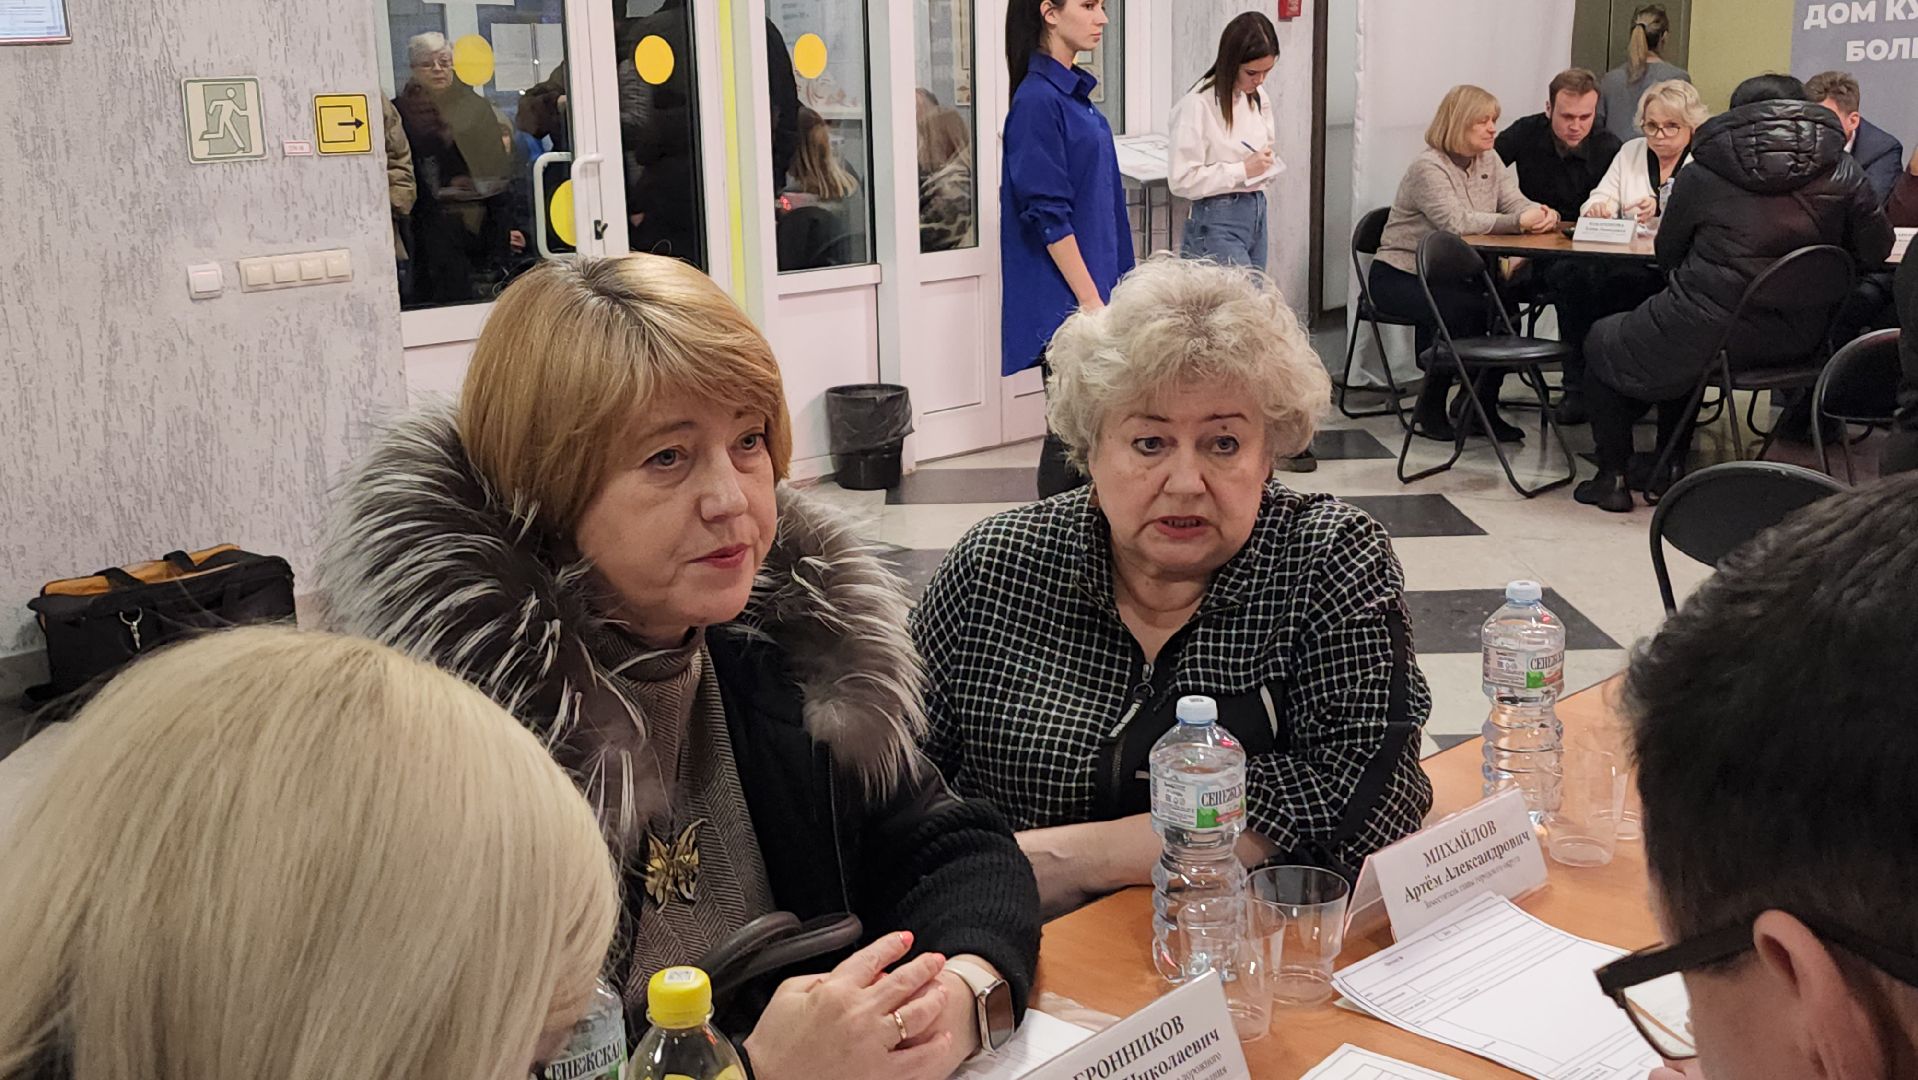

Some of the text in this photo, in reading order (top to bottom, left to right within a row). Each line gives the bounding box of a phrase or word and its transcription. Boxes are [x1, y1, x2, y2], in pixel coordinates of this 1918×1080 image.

[1803, 1, 1877, 30] ДОМ
[1846, 37, 1918, 62] БОЛ
[1422, 820, 1498, 868] МИХАЙЛОВ
[1405, 831, 1531, 903] Артём Александрович
